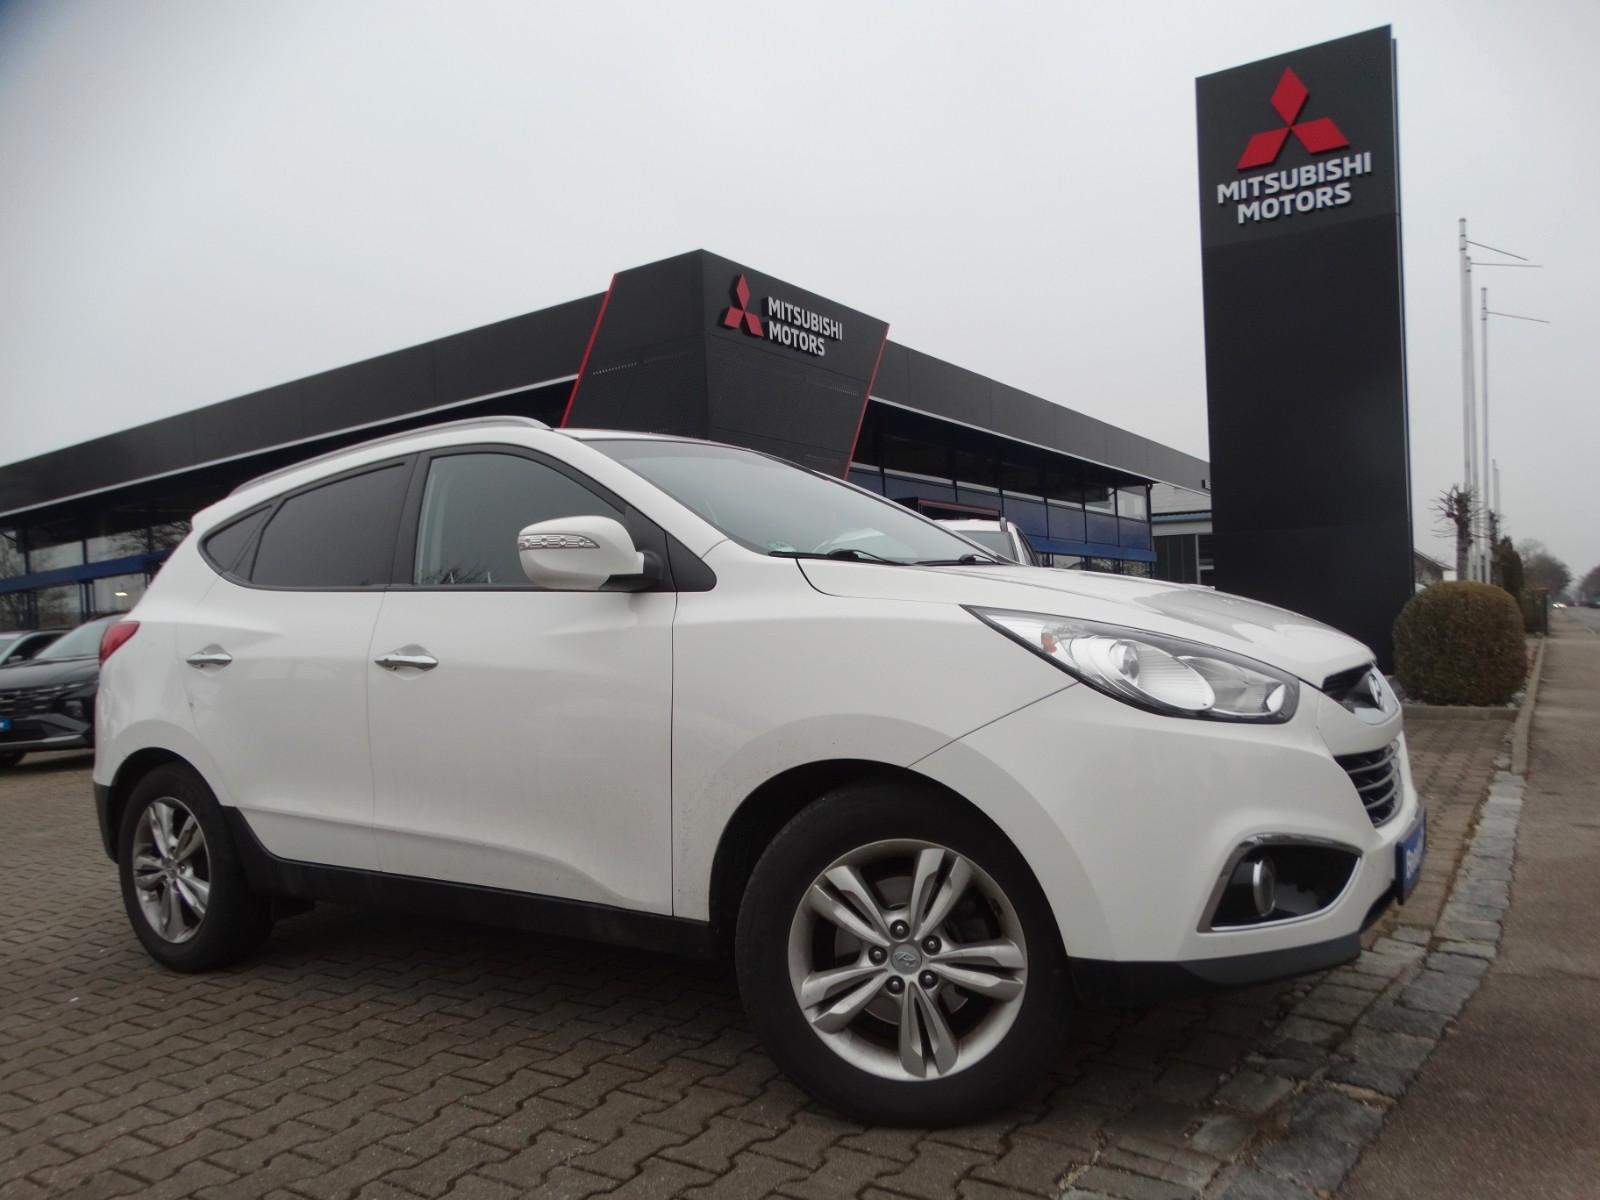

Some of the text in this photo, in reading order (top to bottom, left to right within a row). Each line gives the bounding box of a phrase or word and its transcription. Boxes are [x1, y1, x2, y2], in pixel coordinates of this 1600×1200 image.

[1217, 152, 1371, 203] MITSUBISHI
[1238, 182, 1351, 223] MOTORS
[768, 296, 842, 340] MITSUBISHI
[768, 321, 825, 355] MOTORS
